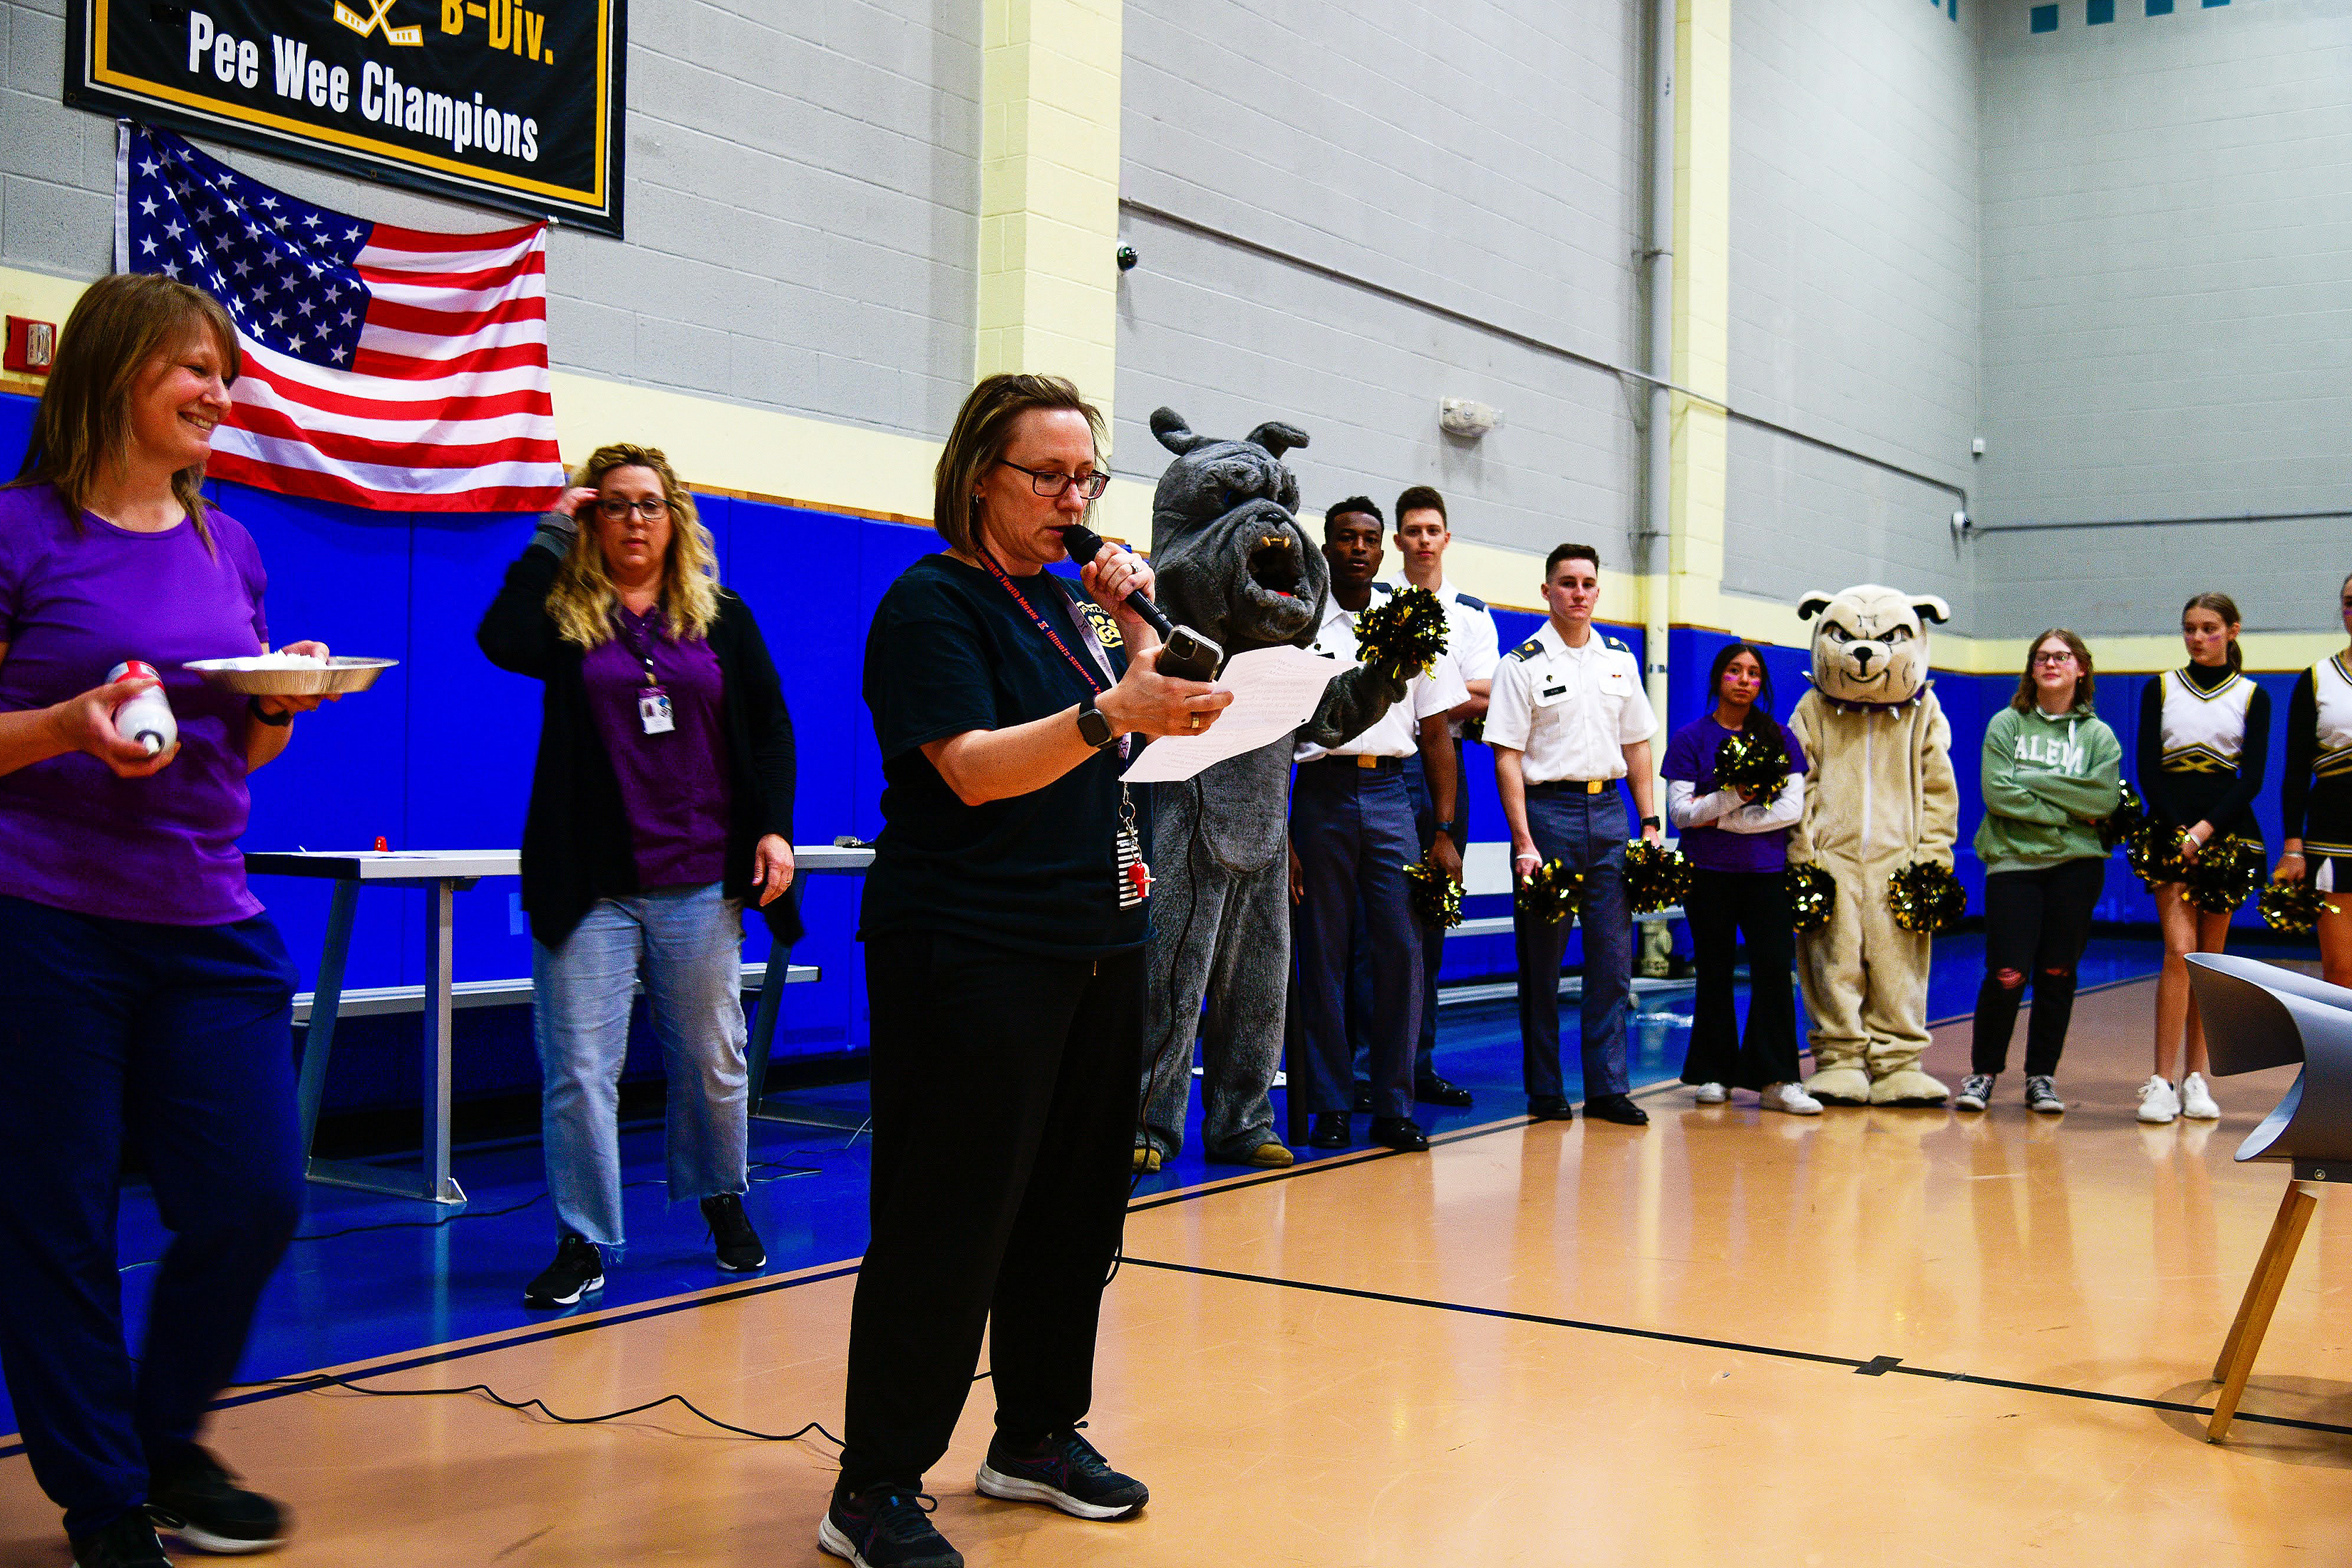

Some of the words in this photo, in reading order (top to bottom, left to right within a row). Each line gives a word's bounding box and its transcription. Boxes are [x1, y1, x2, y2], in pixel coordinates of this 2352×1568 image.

[189, 10, 259, 88] Pee
[272, 34, 349, 113] Wee
[361, 61, 538, 162] Champions
[1000, 576, 1021, 598] Youth
[1017, 597, 1038, 620] Music
[1046, 630, 1071, 656] Illinois
[1068, 656, 1096, 685] Summer
[2013, 734, 2085, 776] ALEM
